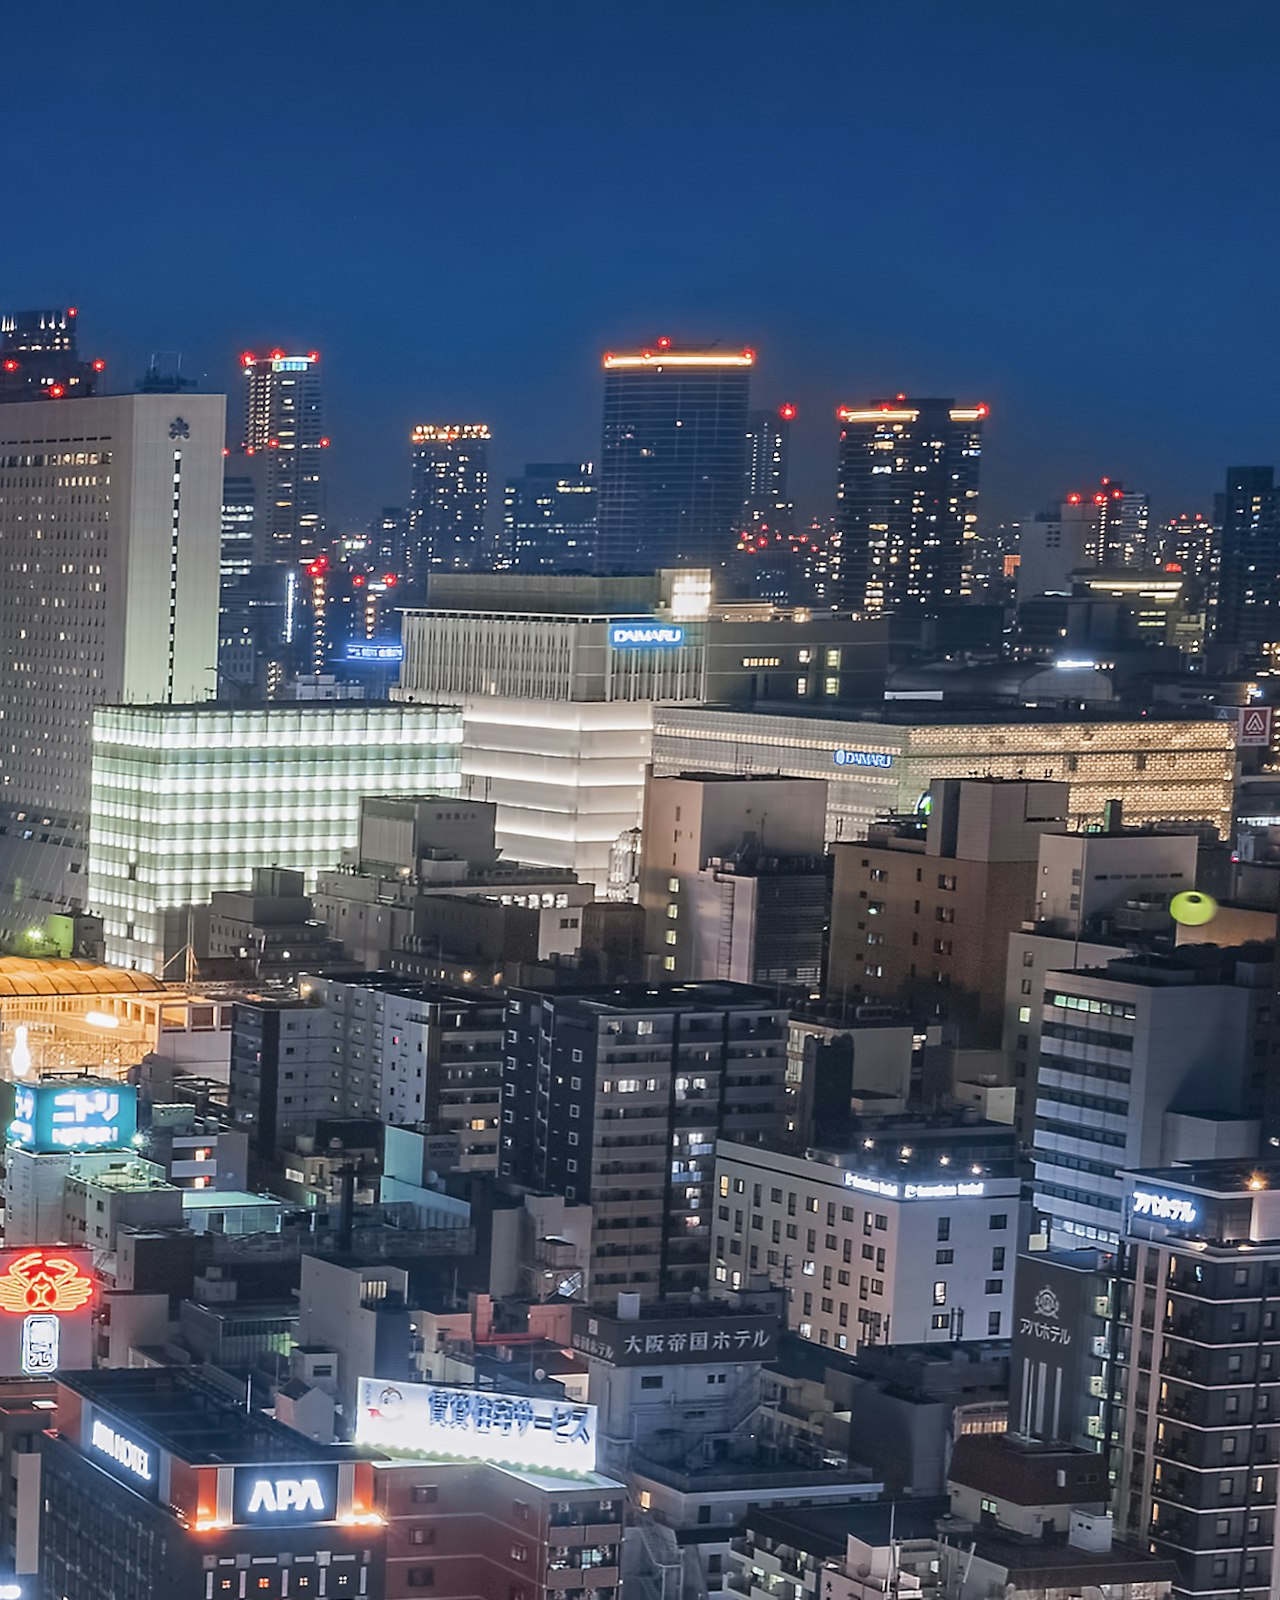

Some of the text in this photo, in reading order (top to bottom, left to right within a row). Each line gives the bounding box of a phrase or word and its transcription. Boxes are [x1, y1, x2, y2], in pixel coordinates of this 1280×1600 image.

[613, 629, 681, 643] DAIMARU
[845, 752, 892, 768] DAIMARU
[52, 1091, 120, 1122] ニトリ
[1133, 1191, 1197, 1222] アパホテル
[623, 1329, 771, 1355] 大阪帝国ホテル
[1020, 1318, 1071, 1345] アパホテル
[247, 1479, 325, 1513] APA
